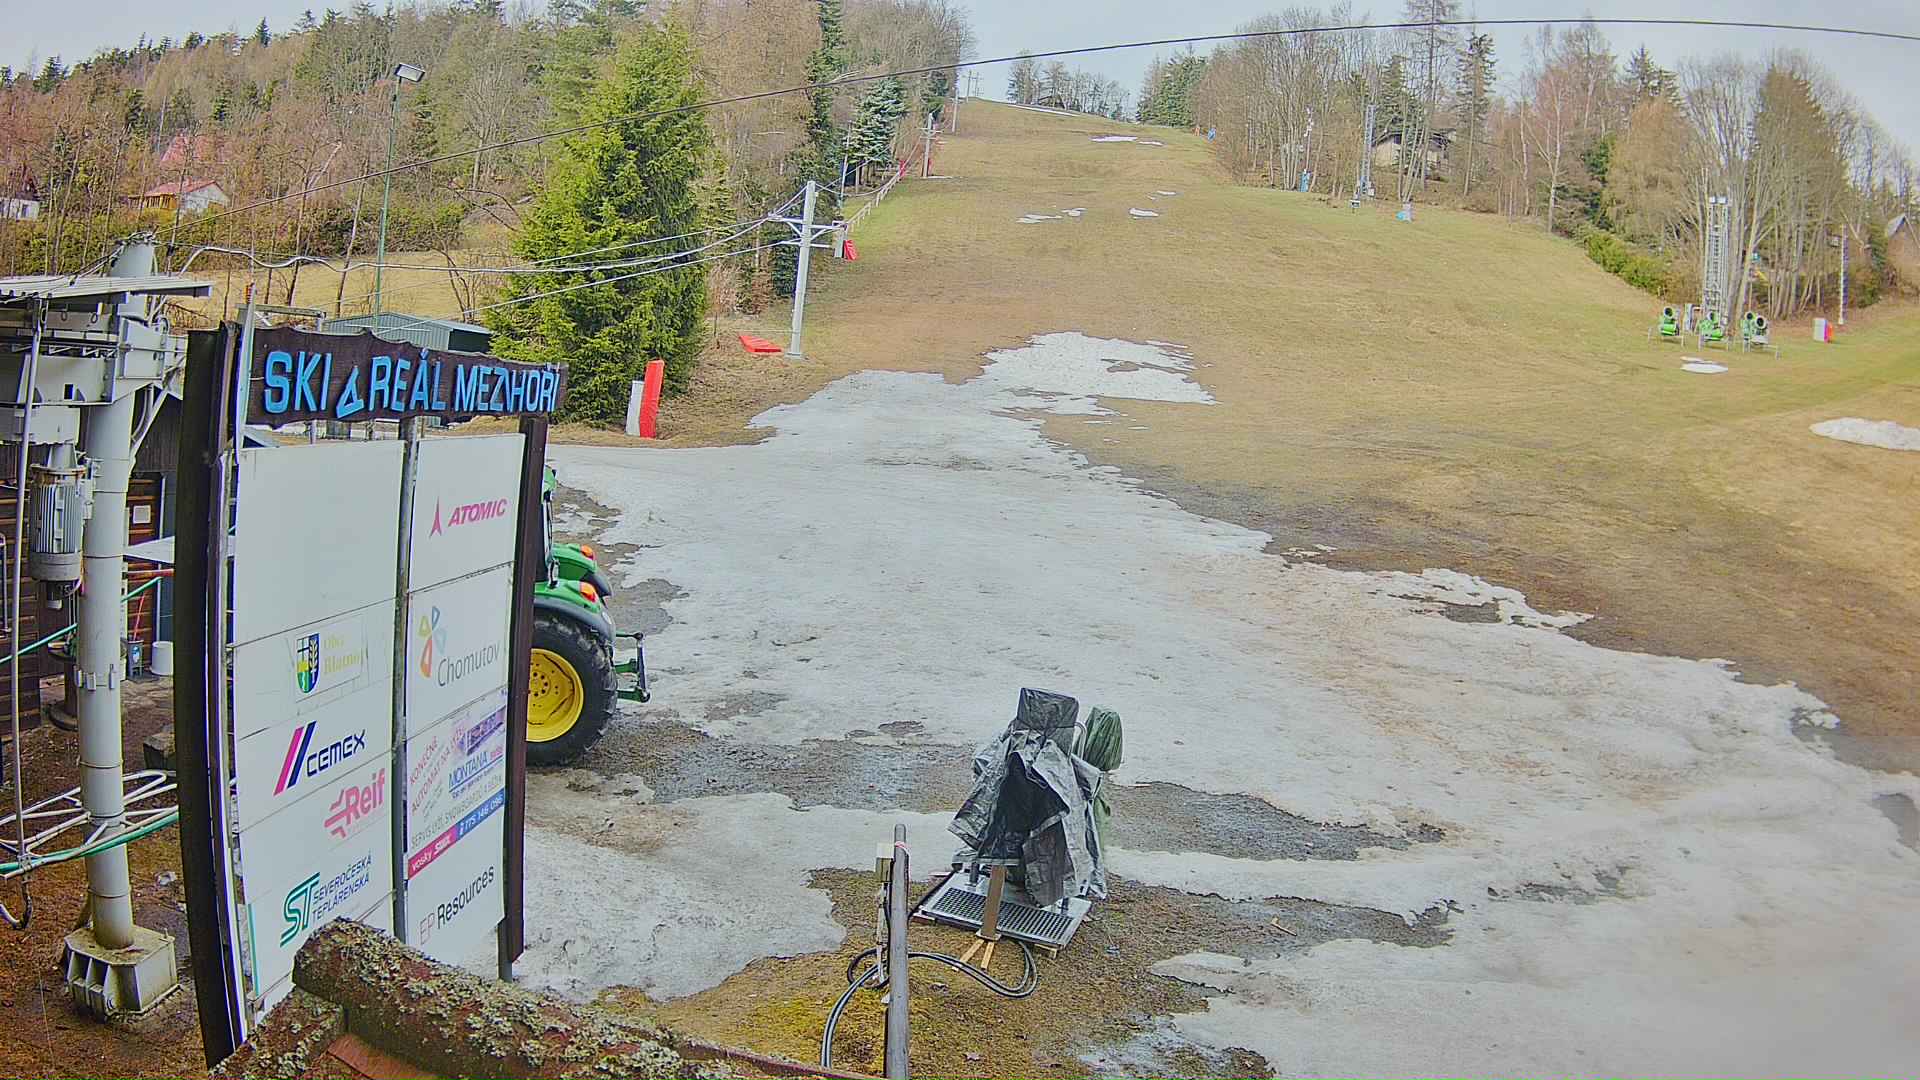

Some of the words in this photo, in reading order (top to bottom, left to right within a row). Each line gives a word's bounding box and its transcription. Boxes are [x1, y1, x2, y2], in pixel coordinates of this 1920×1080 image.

[264, 351, 332, 413] SKI
[448, 498, 508, 527] ATOMIC
[437, 642, 500, 687] Chomutov
[306, 729, 366, 777] CEMEX
[449, 750, 489, 789] MONTANA
[343, 768, 385, 826] Reif
[437, 866, 494, 929] Resources
